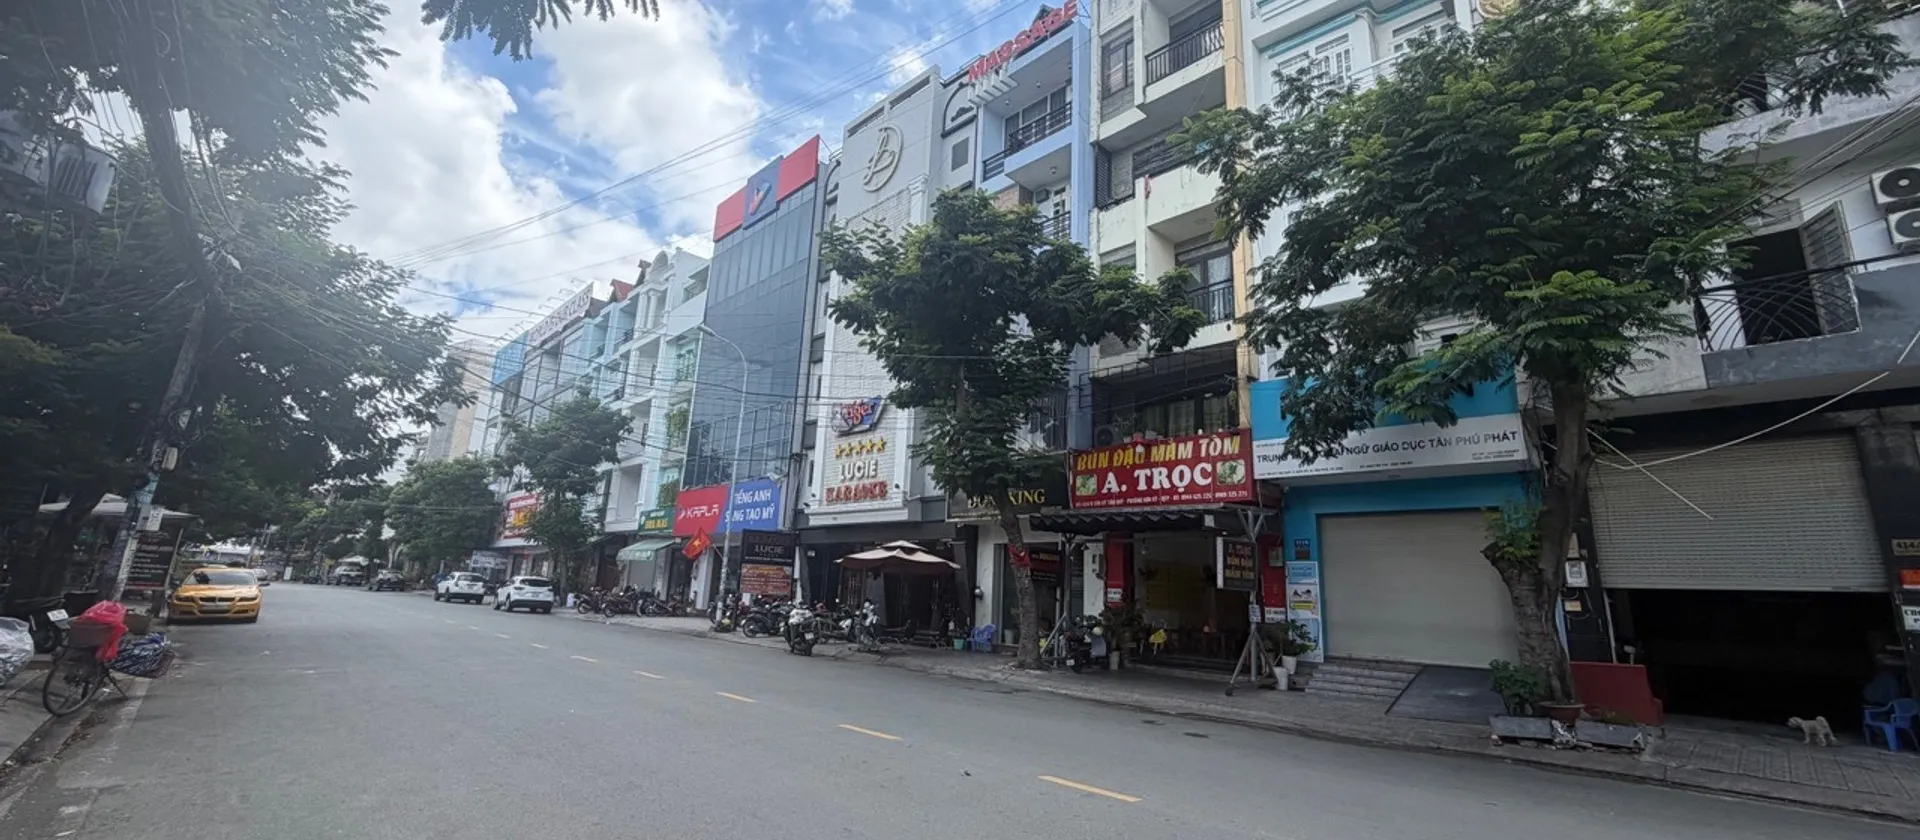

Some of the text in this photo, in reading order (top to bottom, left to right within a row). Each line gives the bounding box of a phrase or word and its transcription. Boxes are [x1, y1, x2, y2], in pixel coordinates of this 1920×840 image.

[967, 0, 1078, 83] MASSAGE
[1373, 440, 1400, 453] GIÁO
[1401, 440, 1426, 452] DỤC
[1483, 429, 1518, 444] PHÁT
[840, 460, 878, 480] LUCIE
[1101, 461, 1213, 494] A. TRỌC
[753, 489, 772, 502] ANH
[825, 481, 889, 504] KARAOKE
